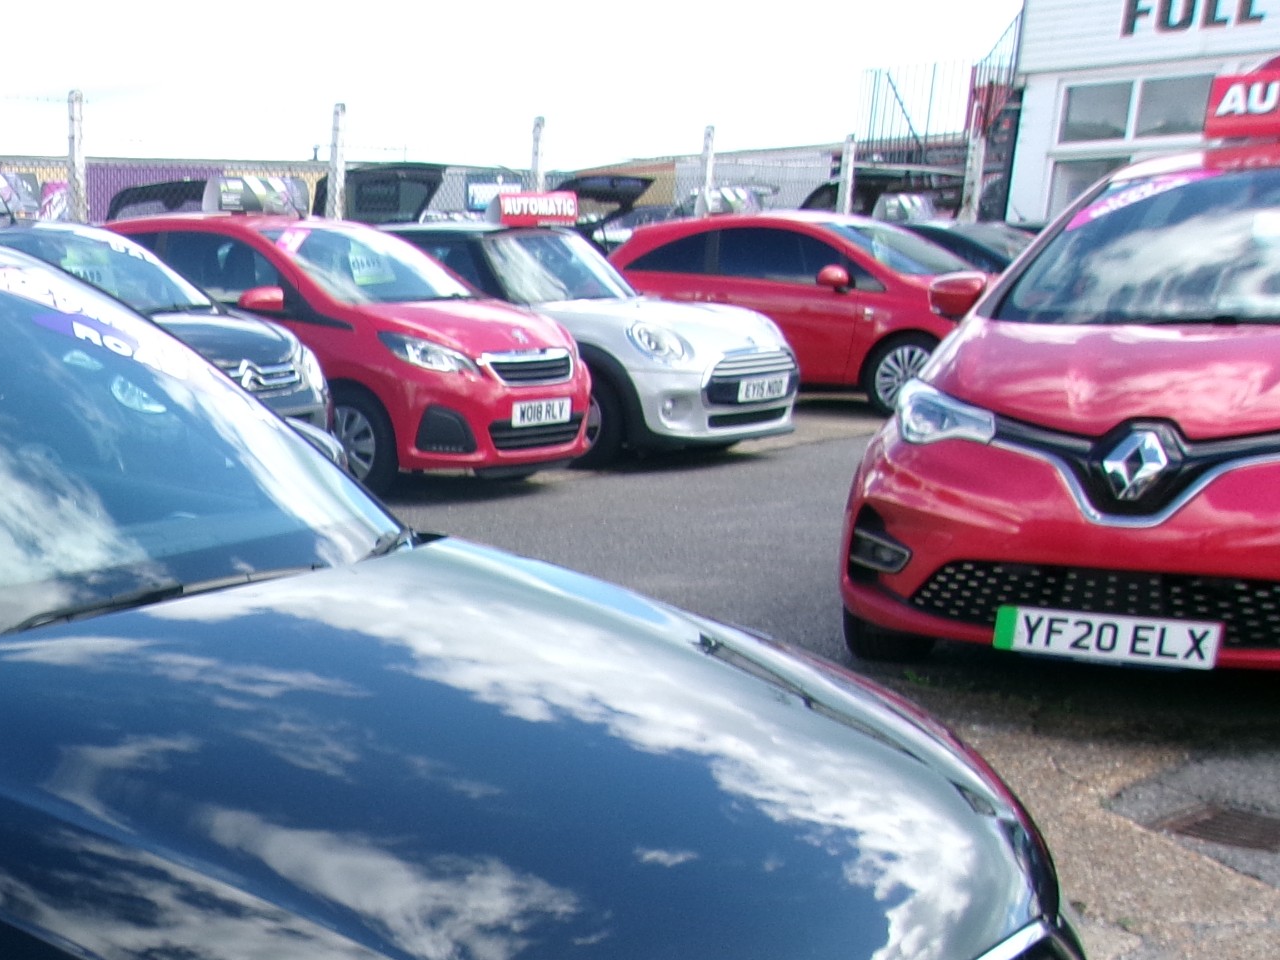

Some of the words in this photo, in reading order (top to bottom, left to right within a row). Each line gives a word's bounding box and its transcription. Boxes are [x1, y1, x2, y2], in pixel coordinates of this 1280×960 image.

[1120, 0, 1266, 37] FULL
[503, 196, 576, 216] AUTOMATIC
[1023, 614, 1120, 653] YF20
[1129, 624, 1210, 661] ELX
